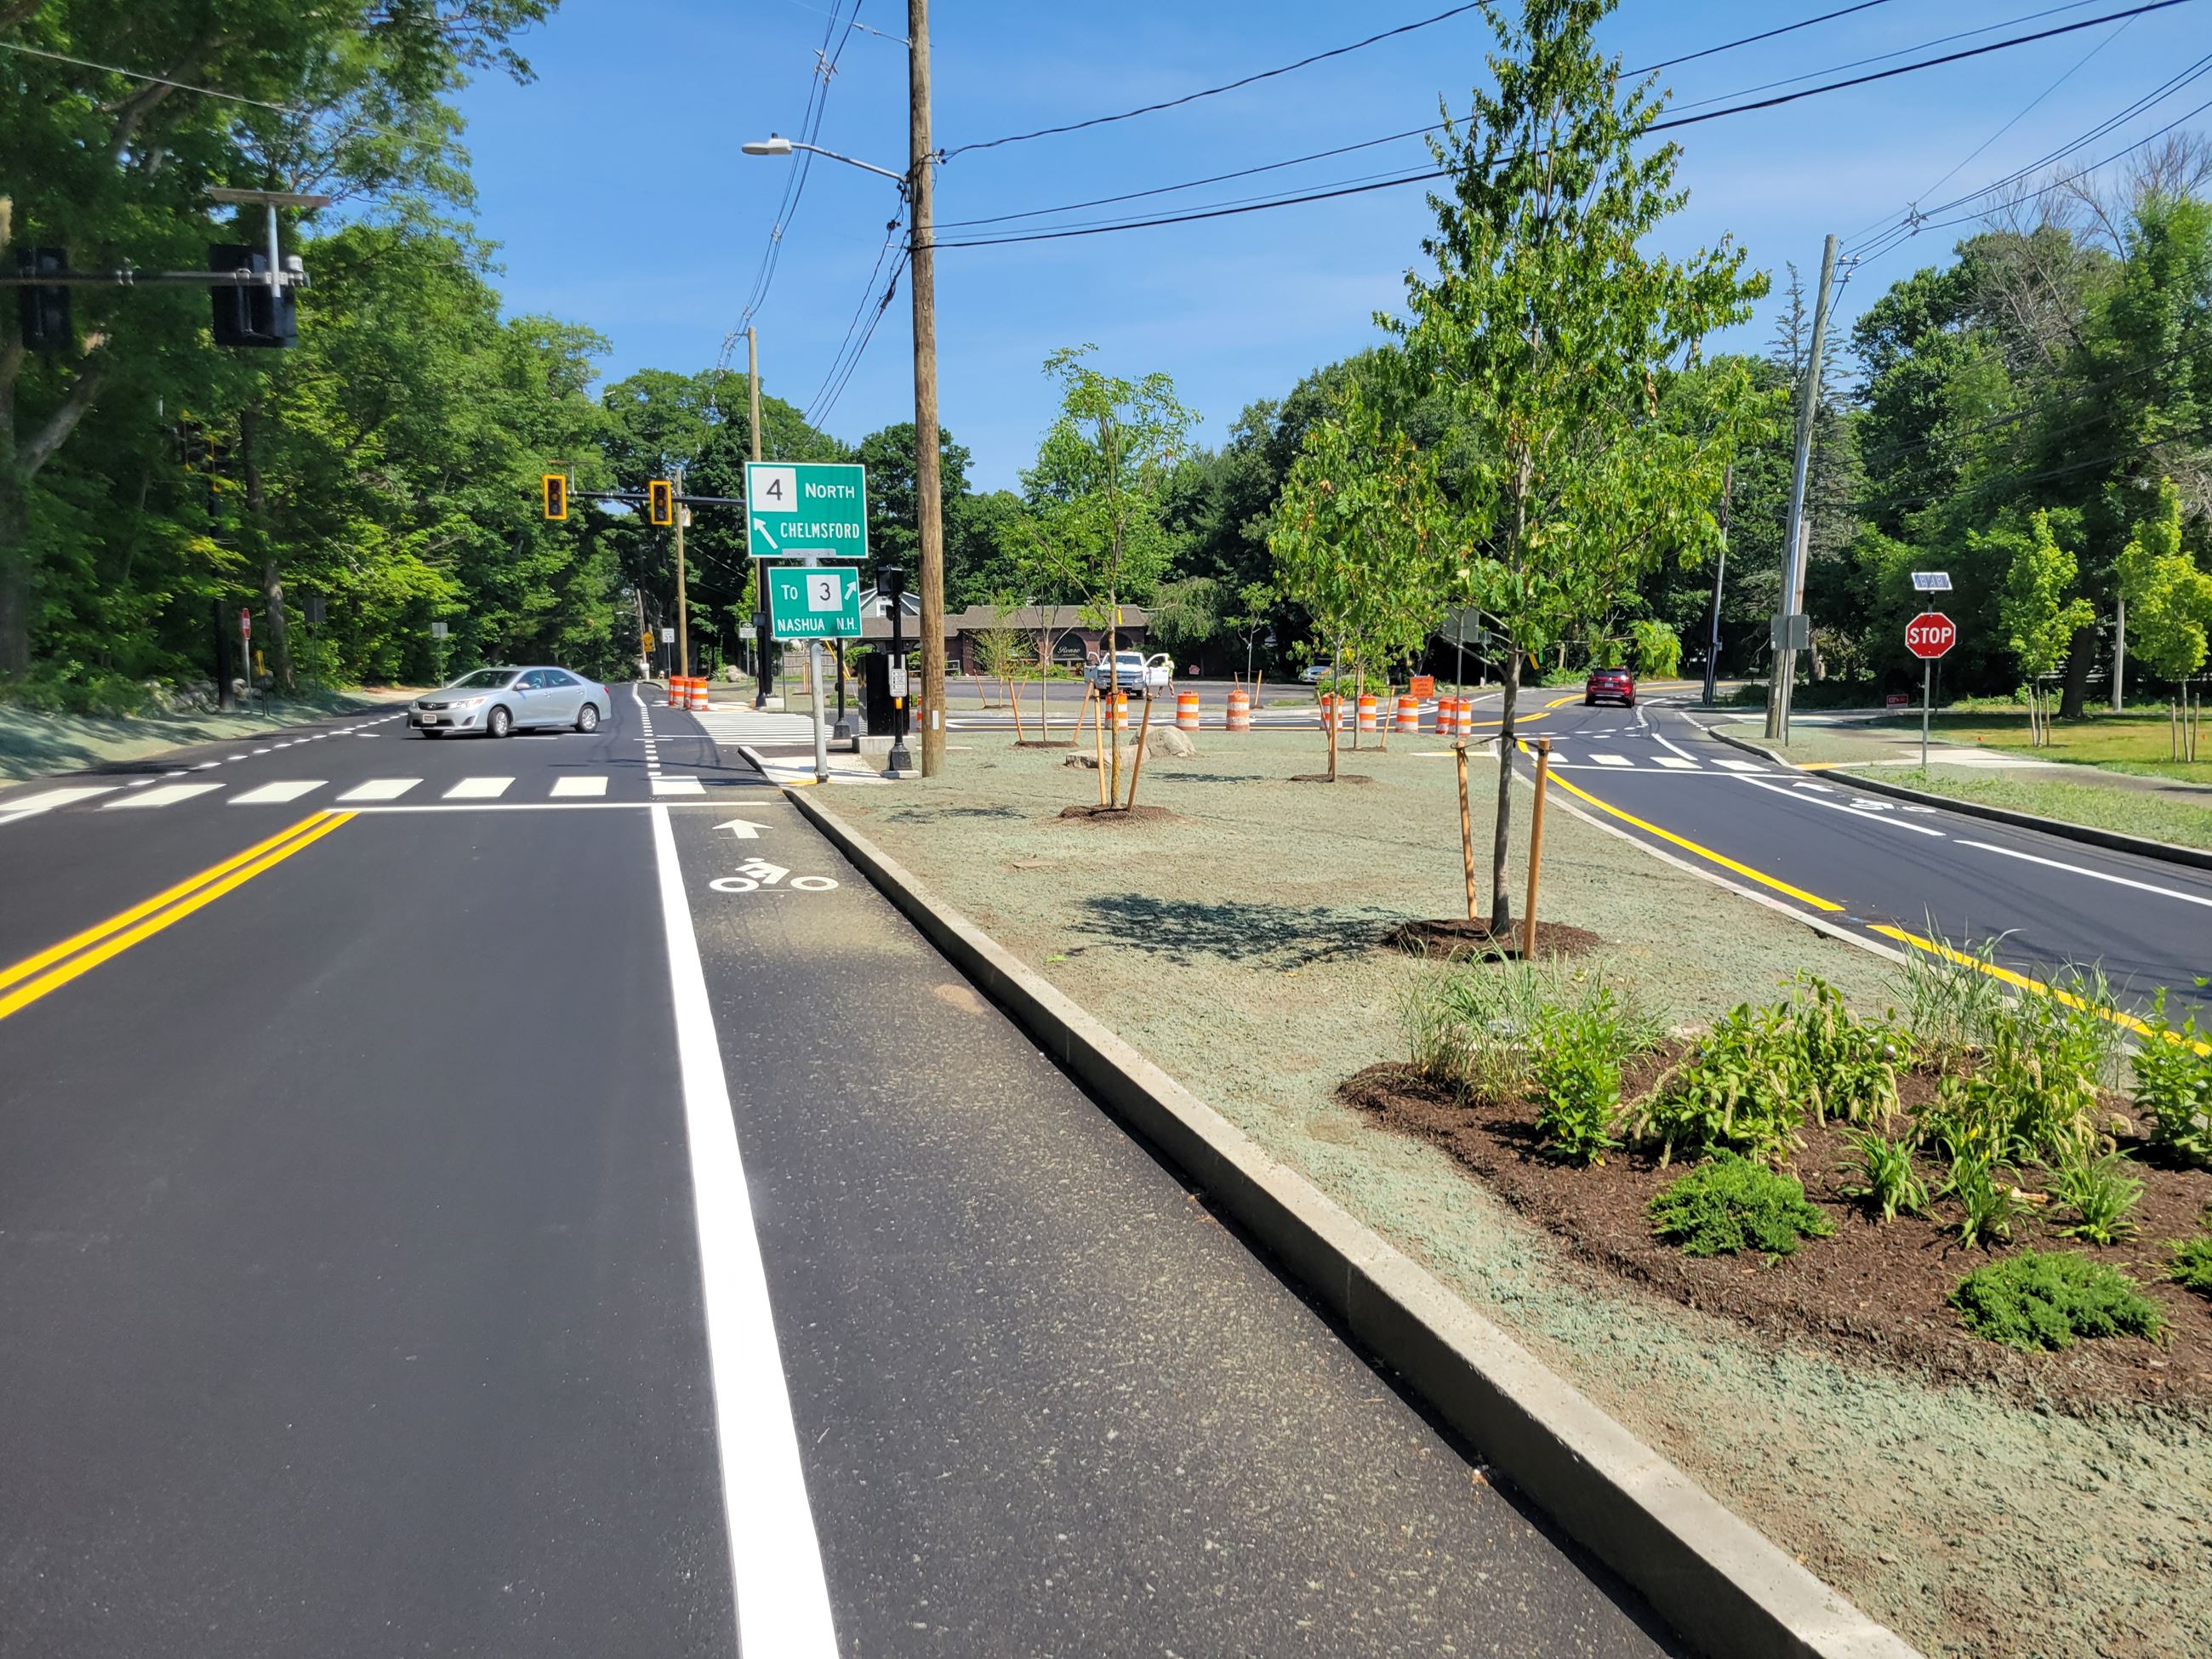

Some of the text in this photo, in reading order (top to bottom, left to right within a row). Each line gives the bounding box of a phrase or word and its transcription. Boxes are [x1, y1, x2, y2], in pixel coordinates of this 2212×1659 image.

[767, 479, 855, 501] 4 NORTH
[780, 522, 860, 539] CHELMSFORD
[819, 582, 831, 601] 3
[777, 618, 858, 632] NASHUA N.H.
[1909, 627, 1952, 644] STOP
